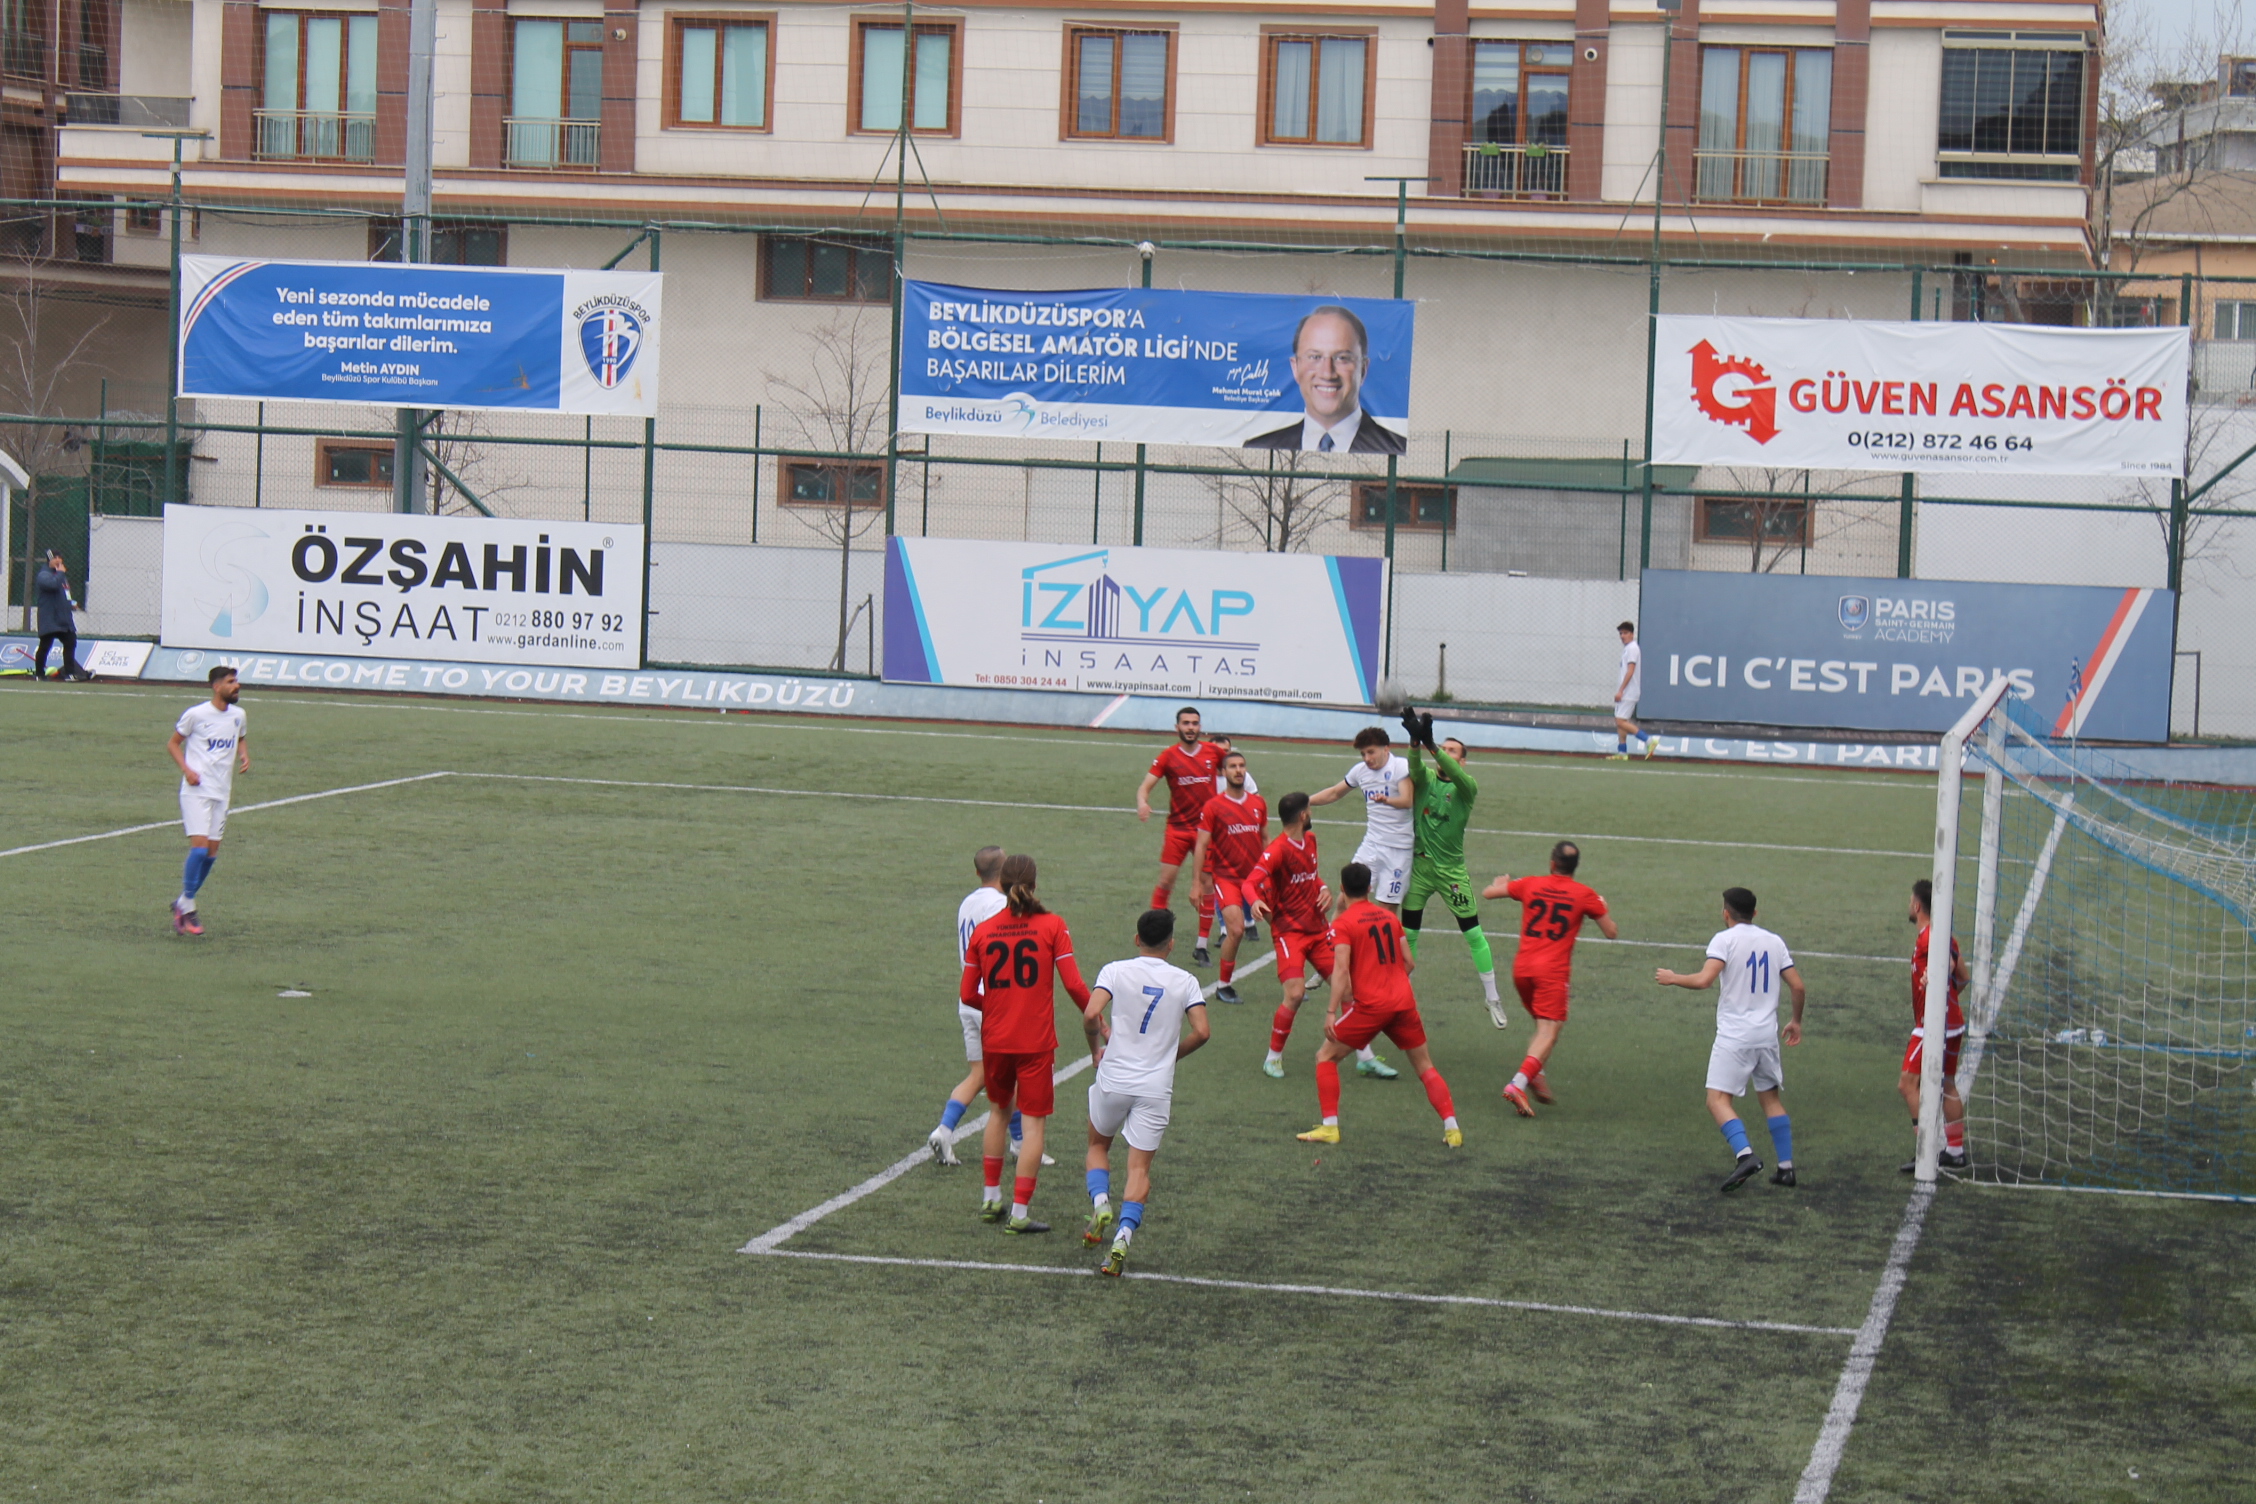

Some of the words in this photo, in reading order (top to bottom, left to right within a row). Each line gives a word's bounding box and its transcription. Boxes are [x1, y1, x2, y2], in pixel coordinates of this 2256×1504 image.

[276, 287, 315, 304] Yeni
[318, 291, 395, 307] sezonda
[399, 292, 490, 311] mücadele
[572, 293, 651, 325] BEYLİKDÜZÜSPOR
[272, 310, 318, 326] eden
[322, 311, 359, 327] tüm
[363, 313, 492, 333] takımlarımıza
[929, 299, 1146, 329] BEYLİKDÜZÜSPOR'A
[304, 332, 387, 353] başarılar
[389, 336, 458, 354] dilerim.
[927, 325, 1036, 354] BÖLGESEL
[1040, 332, 1138, 357] AMATÖR
[1144, 334, 1238, 362] LİGİ'NDE
[321, 373, 362, 383] Beylikdüzü
[363, 375, 380, 384] Spor
[381, 376, 407, 384] Kulübü
[408, 377, 439, 387] Başkanı
[341, 362, 378, 374] Metin
[379, 363, 420, 376] AYDIN
[927, 358, 1038, 384] BAŞARILAR
[1044, 359, 1126, 386] DİLERİM
[1212, 386, 1240, 395] Mehmet
[1241, 388, 1262, 396] Murat
[1788, 370, 1937, 416] GÜVEN
[1949, 377, 2163, 422] ASANSÖR
[925, 406, 1002, 423] Beylikdüzü
[1040, 412, 1108, 430] Belediyesi
[1847, 432, 1915, 450] 0(212)
[1922, 434, 1962, 449] 872
[1969, 435, 1998, 450] 46
[2004, 436, 2034, 451] 64
[1871, 452, 2009, 464] www.guvenasansor.com.tr
[2121, 461, 2147, 470] Since
[2149, 463, 2173, 471] 1984
[292, 524, 605, 597] ÖZŞAHİN
[298, 591, 490, 646] İNŞAAT
[495, 613, 527, 627] 0212
[531, 609, 565, 630] 880
[572, 612, 594, 630] 97
[601, 614, 623, 632] 92
[1875, 598, 1956, 621] PARIS
[487, 633, 625, 651] www.gardanline.com
[1874, 628, 1954, 644] ACADEMY
[219, 656, 411, 686] WELCOME
[418, 667, 470, 688] TO
[480, 670, 588, 695] YOUR
[600, 673, 857, 708] BEYLIKDÜZÜ
[975, 674, 990, 684] Tel:
[994, 675, 1017, 684] 0850
[1020, 676, 1038, 686] 304
[1041, 677, 1052, 687] 24
[1055, 678, 1067, 687] 44
[1669, 653, 1727, 688] ICI
[1743, 656, 1878, 694] C'EST
[1087, 680, 1192, 693] www.izyapinsaat.com
[1208, 684, 1322, 700] izyapinsaat@gmail.com
[207, 735, 236, 752] yovi
[1390, 881, 1401, 894] 16
[1450, 892, 1469, 907] 24
[1525, 898, 1573, 942] 25
[1368, 922, 1396, 965] 11
[986, 938, 1039, 989] 26
[1746, 951, 1769, 994] 11
[1140, 985, 1165, 1034] 7
